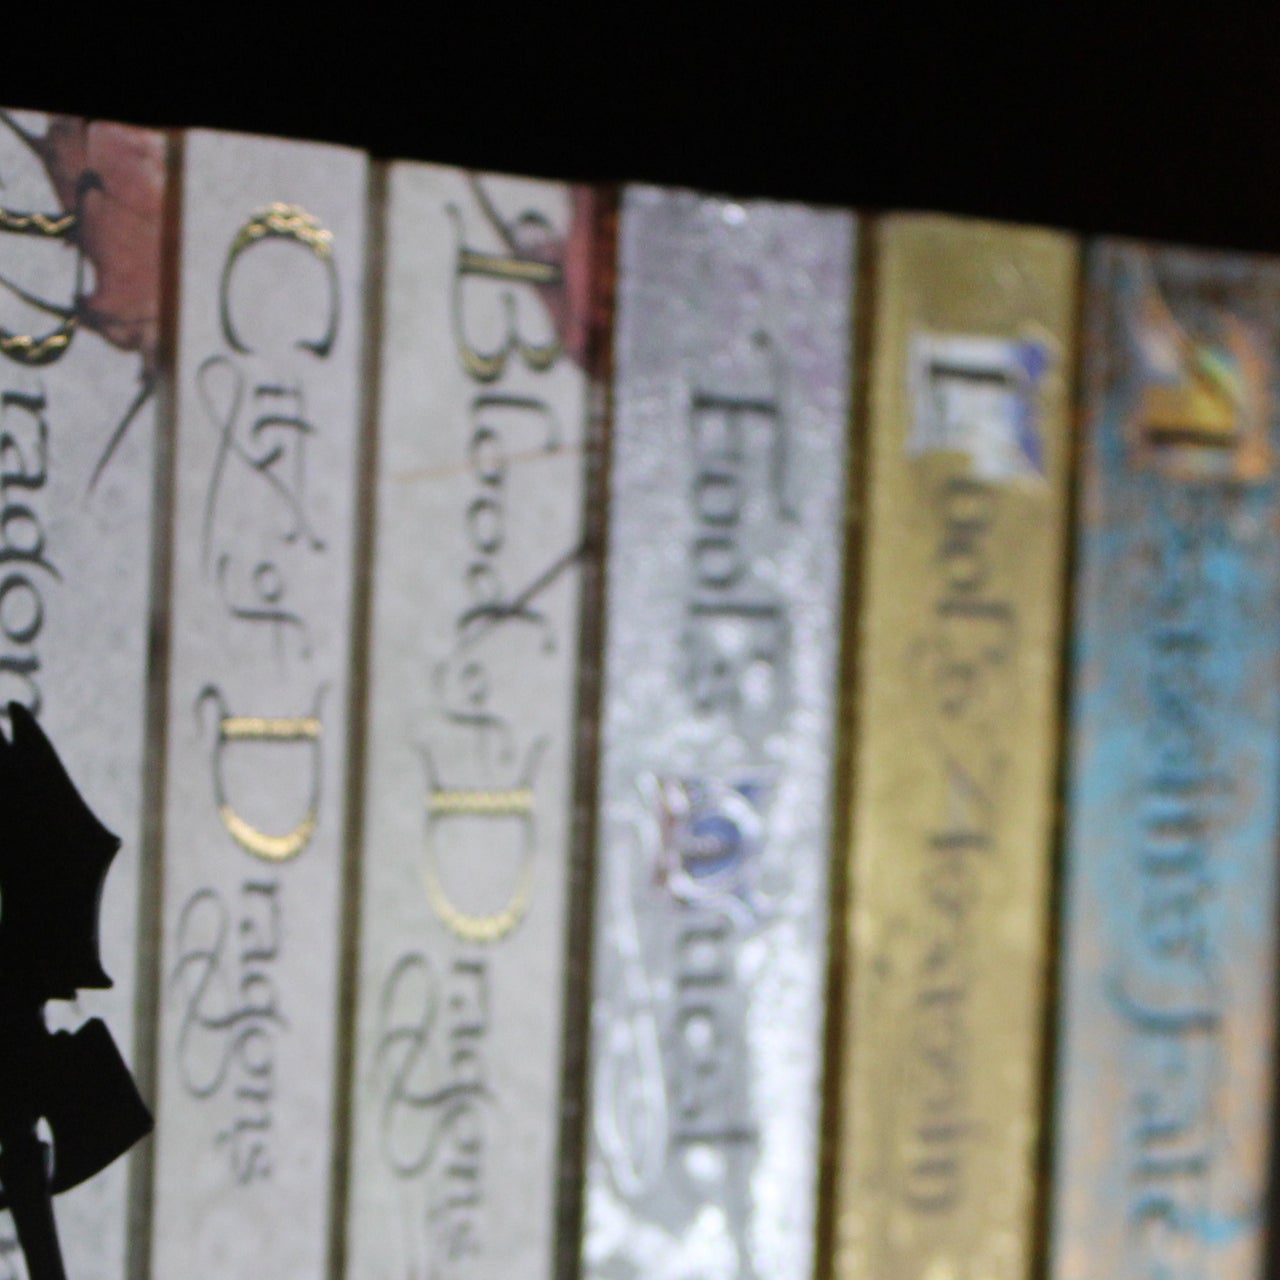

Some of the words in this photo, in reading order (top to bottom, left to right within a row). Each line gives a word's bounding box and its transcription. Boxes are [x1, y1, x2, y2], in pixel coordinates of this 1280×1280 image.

[196, 203, 342, 565] City
[448, 204, 565, 655] Blood
[171, 684, 330, 1187] Dragons
[373, 733, 552, 1262] Dragons
